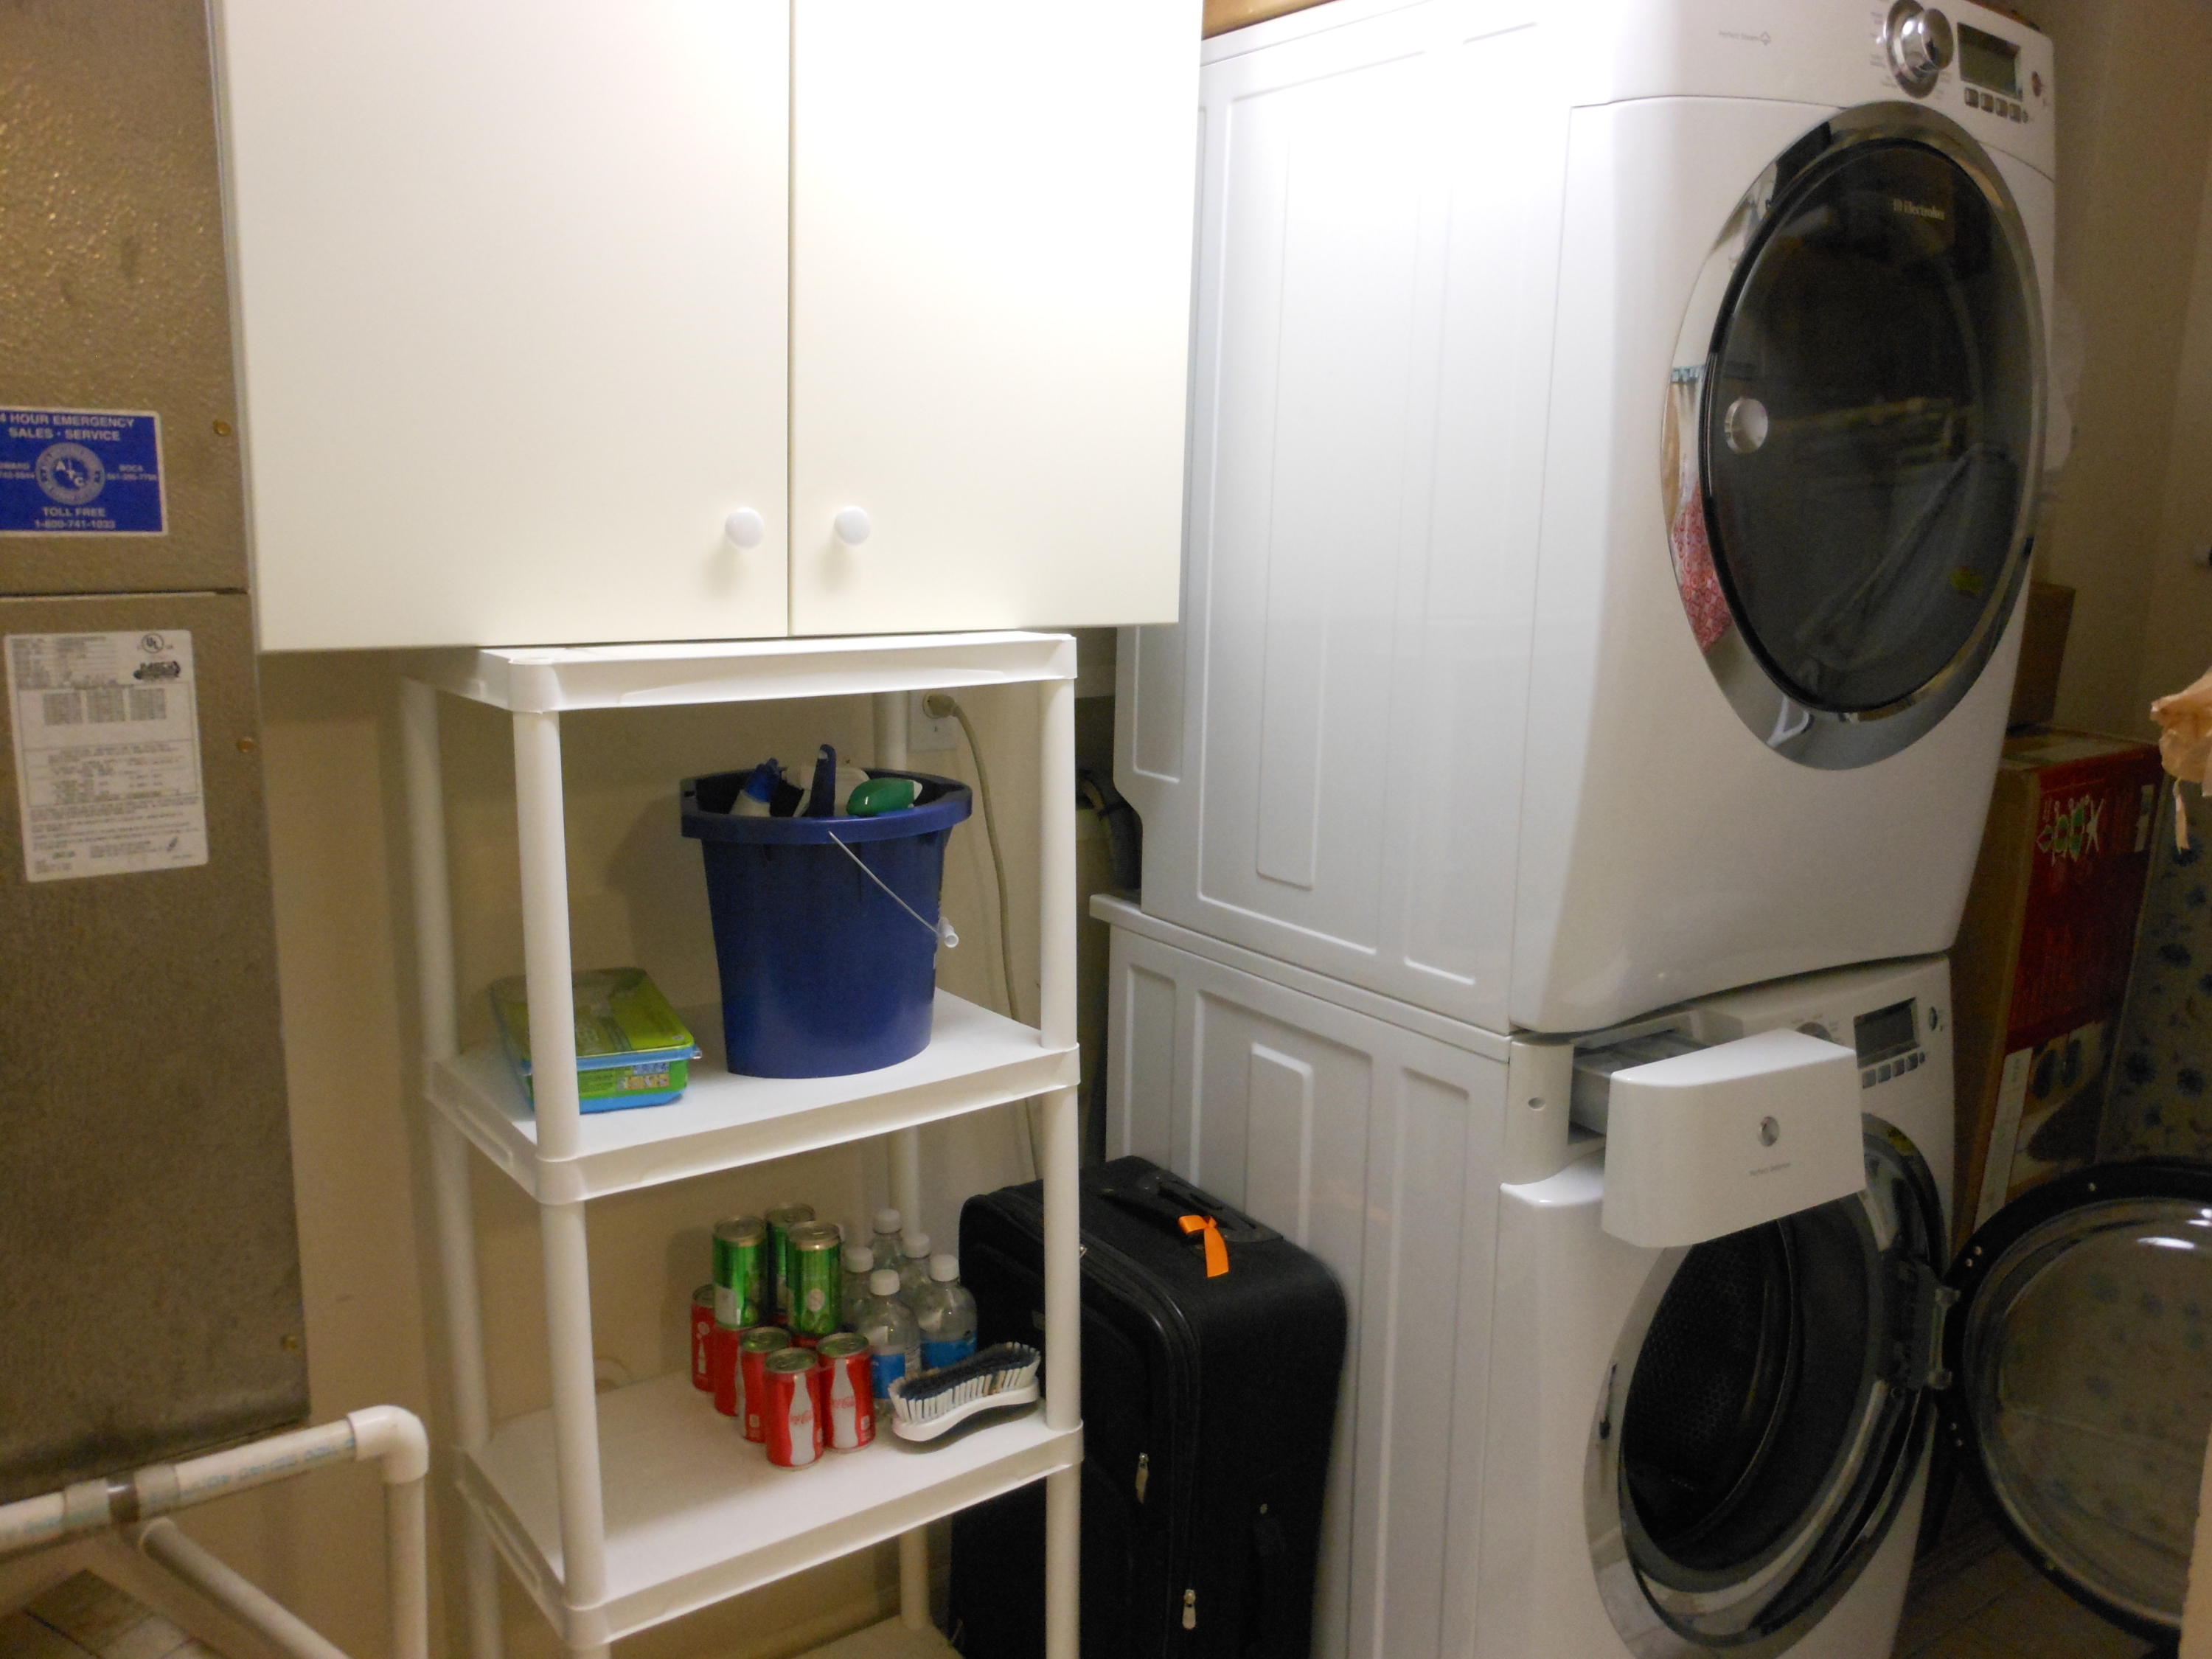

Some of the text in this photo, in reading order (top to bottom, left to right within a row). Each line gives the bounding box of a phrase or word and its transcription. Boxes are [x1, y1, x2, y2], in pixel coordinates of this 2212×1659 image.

[10, 414, 49, 425] HOUR
[52, 416, 135, 428] EMERGENCY
[8, 427, 121, 442] SALES SERVICE
[42, 506, 106, 518] TOLL FREE
